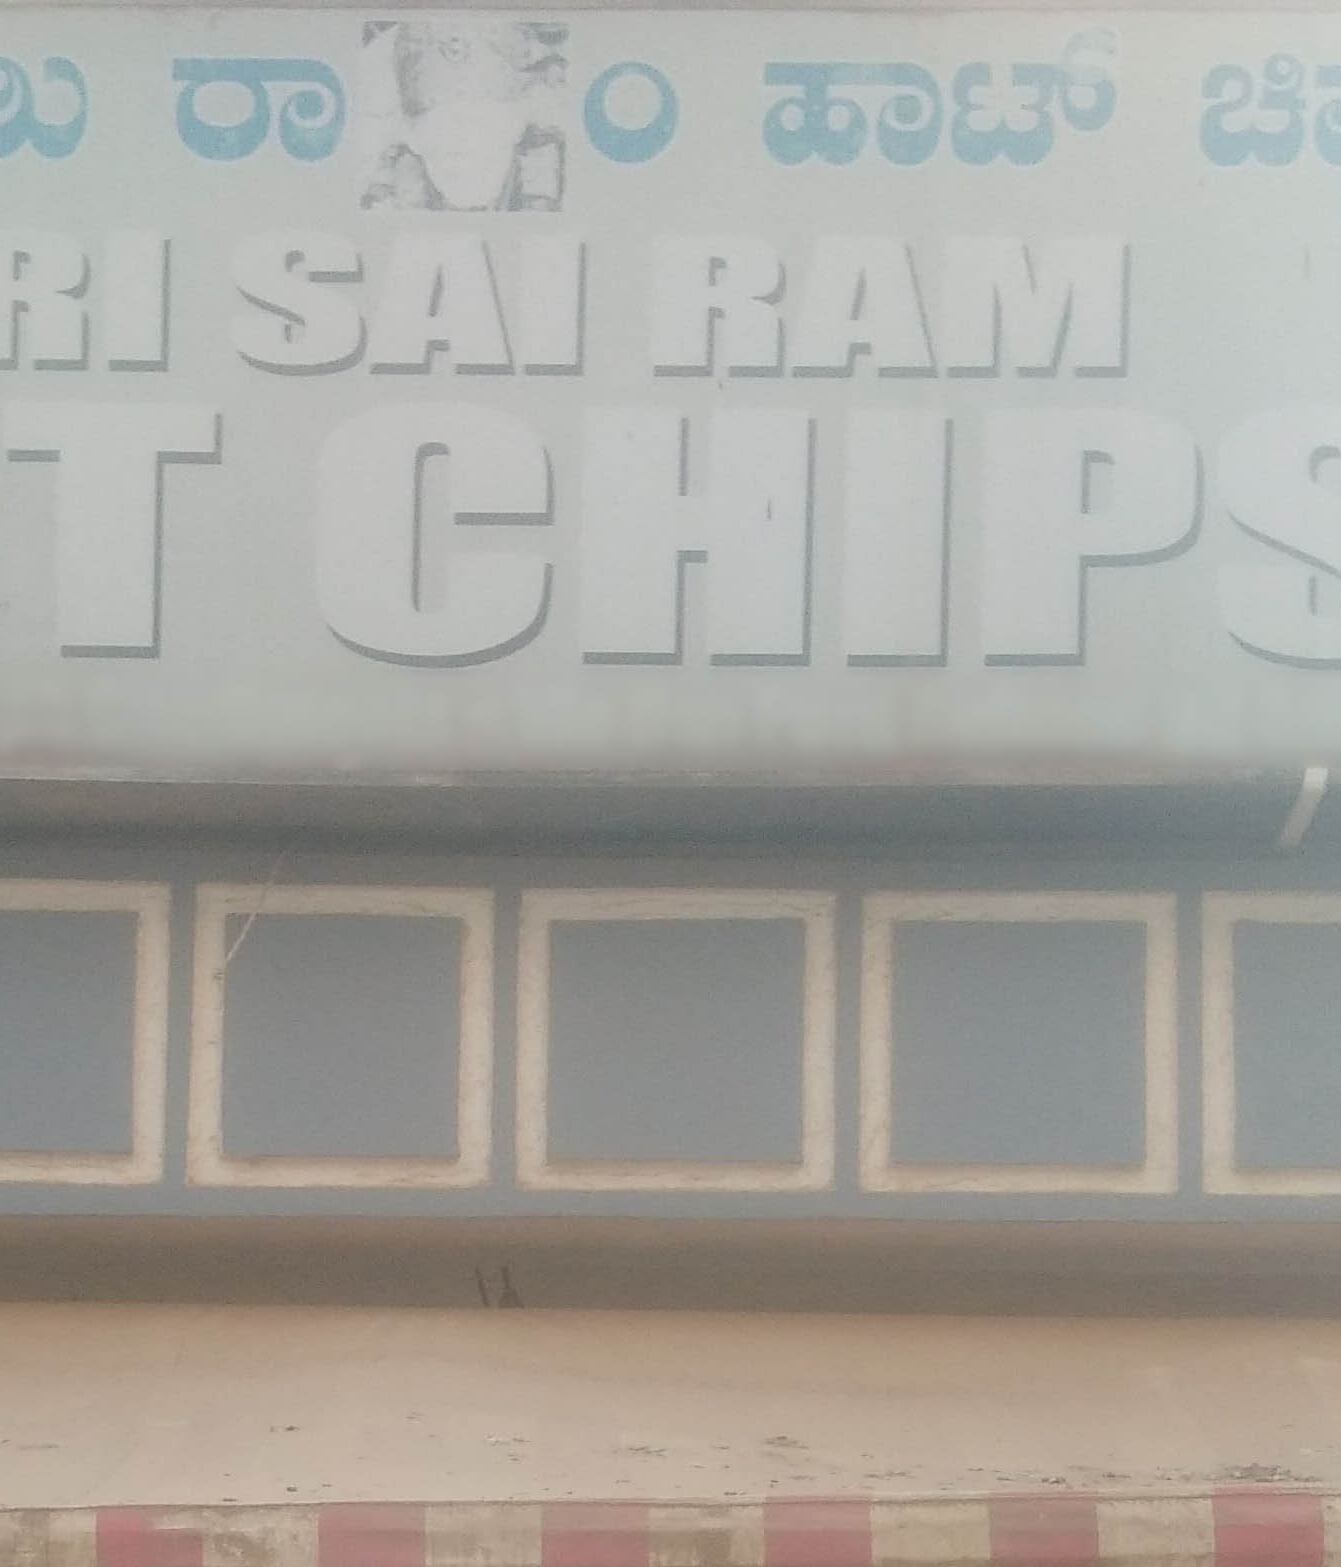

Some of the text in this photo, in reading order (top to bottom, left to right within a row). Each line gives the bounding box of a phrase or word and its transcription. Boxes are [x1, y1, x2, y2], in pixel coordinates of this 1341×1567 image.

[762, 31, 1117, 167] ಹಾಟ್
[232, 231, 588, 377] SAI
[653, 233, 1132, 380] RAM
